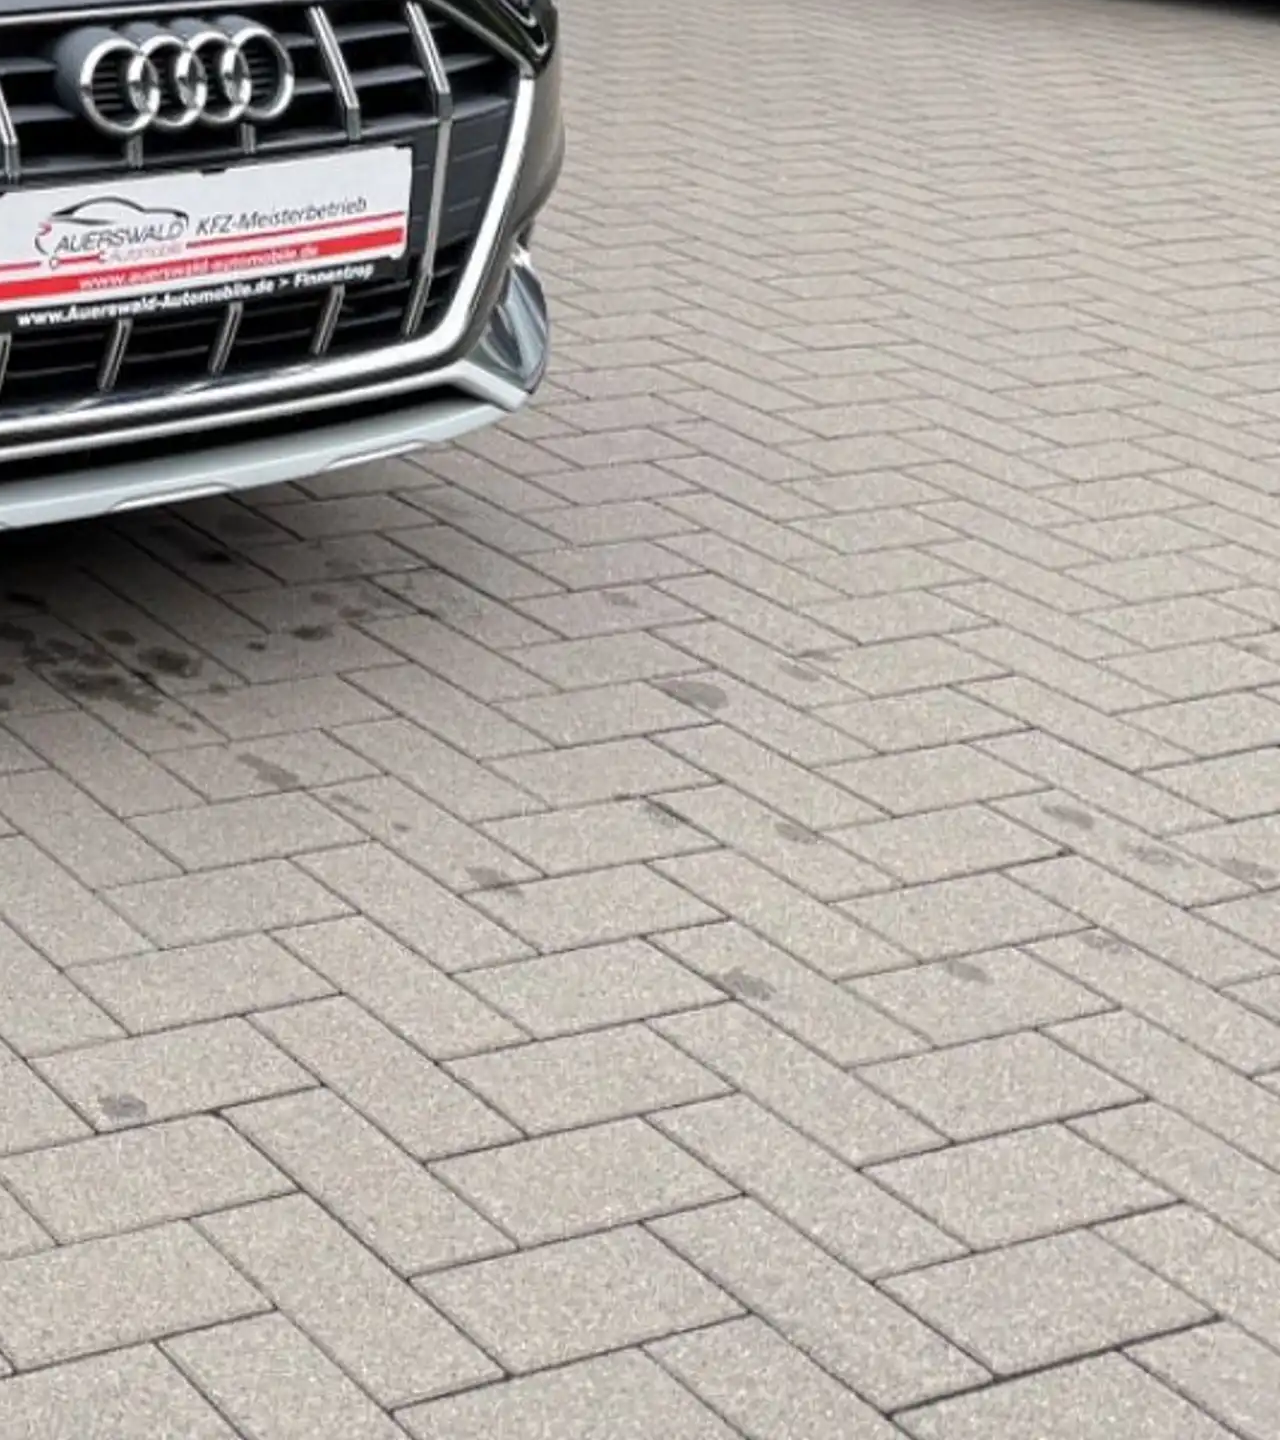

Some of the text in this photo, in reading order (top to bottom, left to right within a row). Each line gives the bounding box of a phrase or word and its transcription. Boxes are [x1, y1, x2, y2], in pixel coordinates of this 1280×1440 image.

[196, 196, 367, 236] KFZ-Meisterbetrieb
[54, 219, 185, 254] AUERSWALD
[17, 278, 275, 327] www.Auerswald-Automobile.de
